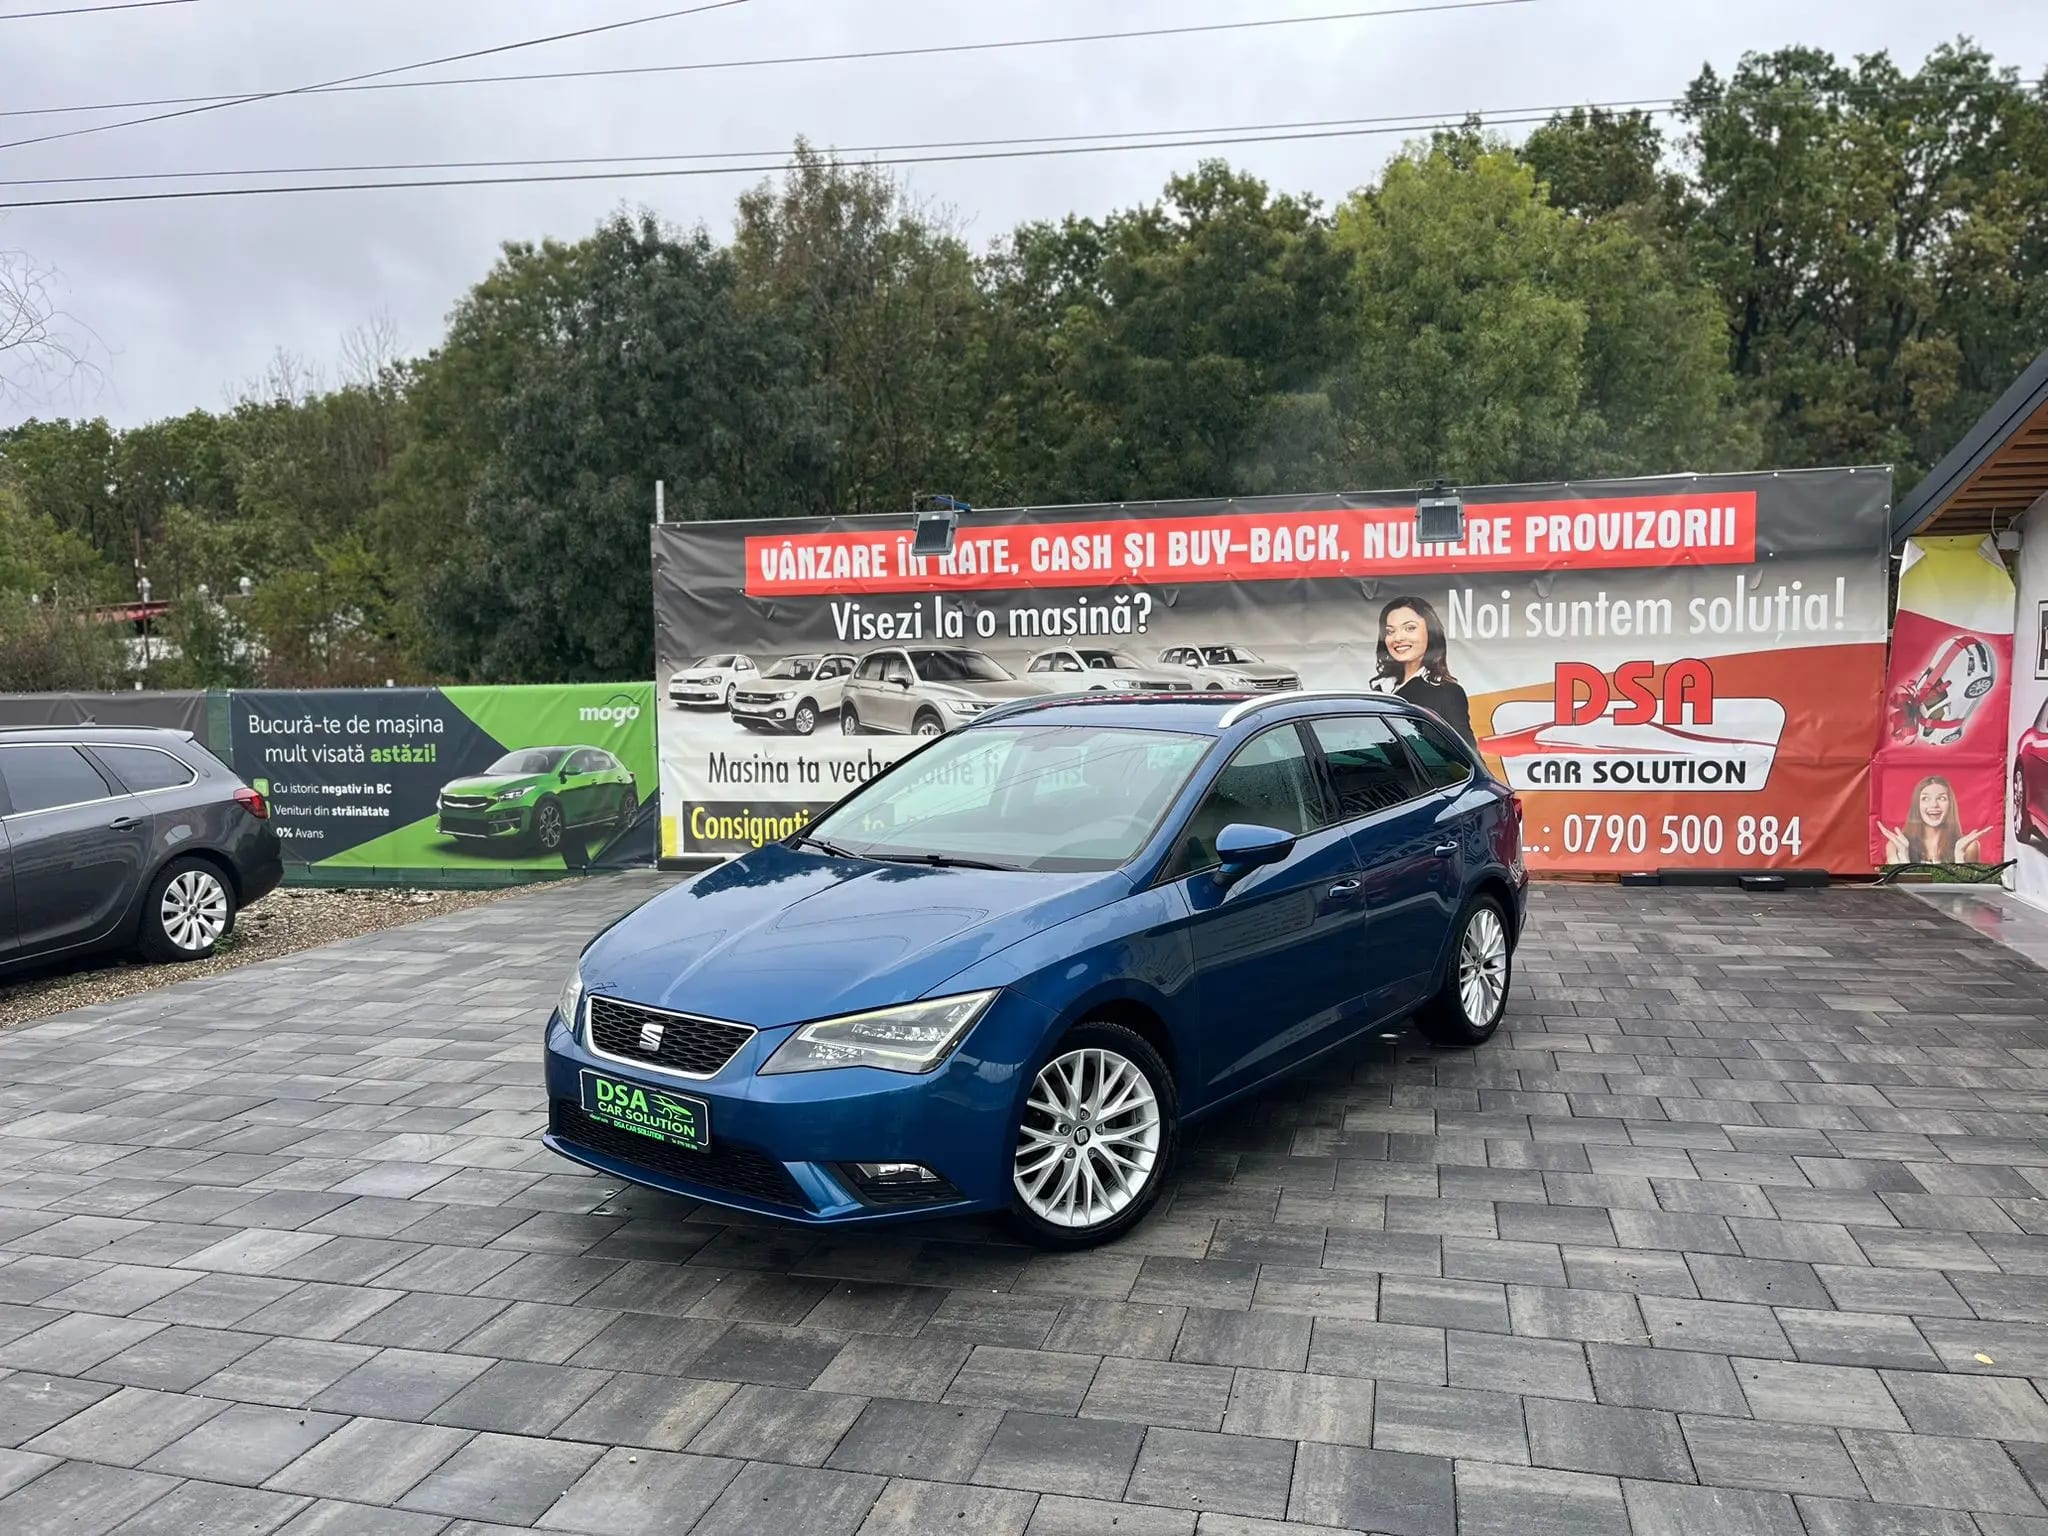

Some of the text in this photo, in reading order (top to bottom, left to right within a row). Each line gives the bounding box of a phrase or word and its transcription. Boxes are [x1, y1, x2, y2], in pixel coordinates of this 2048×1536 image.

[760, 541, 888, 582] VÂNZARE
[1030, 534, 1112, 573] CASH
[1168, 523, 1350, 567] BUY-BACK,
[1525, 506, 1736, 554] PROVIZORII
[830, 602, 923, 641] Visezi
[934, 595, 964, 639] la
[975, 608, 997, 638] o
[1448, 587, 1511, 640] Noi
[1525, 591, 1673, 637] suntem
[1554, 657, 1714, 726] DSA
[248, 714, 444, 738] Bucură-te de mașina
[579, 706, 640, 728] mogo
[265, 744, 437, 763] mult visată astăzi!
[797, 756, 820, 784] ta
[1526, 760, 1746, 784] CAR SOLUTION
[273, 782, 392, 796] Cu istoric negativ in BC
[274, 804, 390, 817] Venituri din străinătate
[276, 827, 324, 838] 0% Avans
[1563, 813, 1647, 853] 0790
[1659, 815, 1724, 855] 500
[1736, 815, 1802, 856] 884
[596, 1079, 649, 1113] DSA
[598, 1101, 623, 1118] CAR
[624, 1108, 695, 1138] SOLUTION
